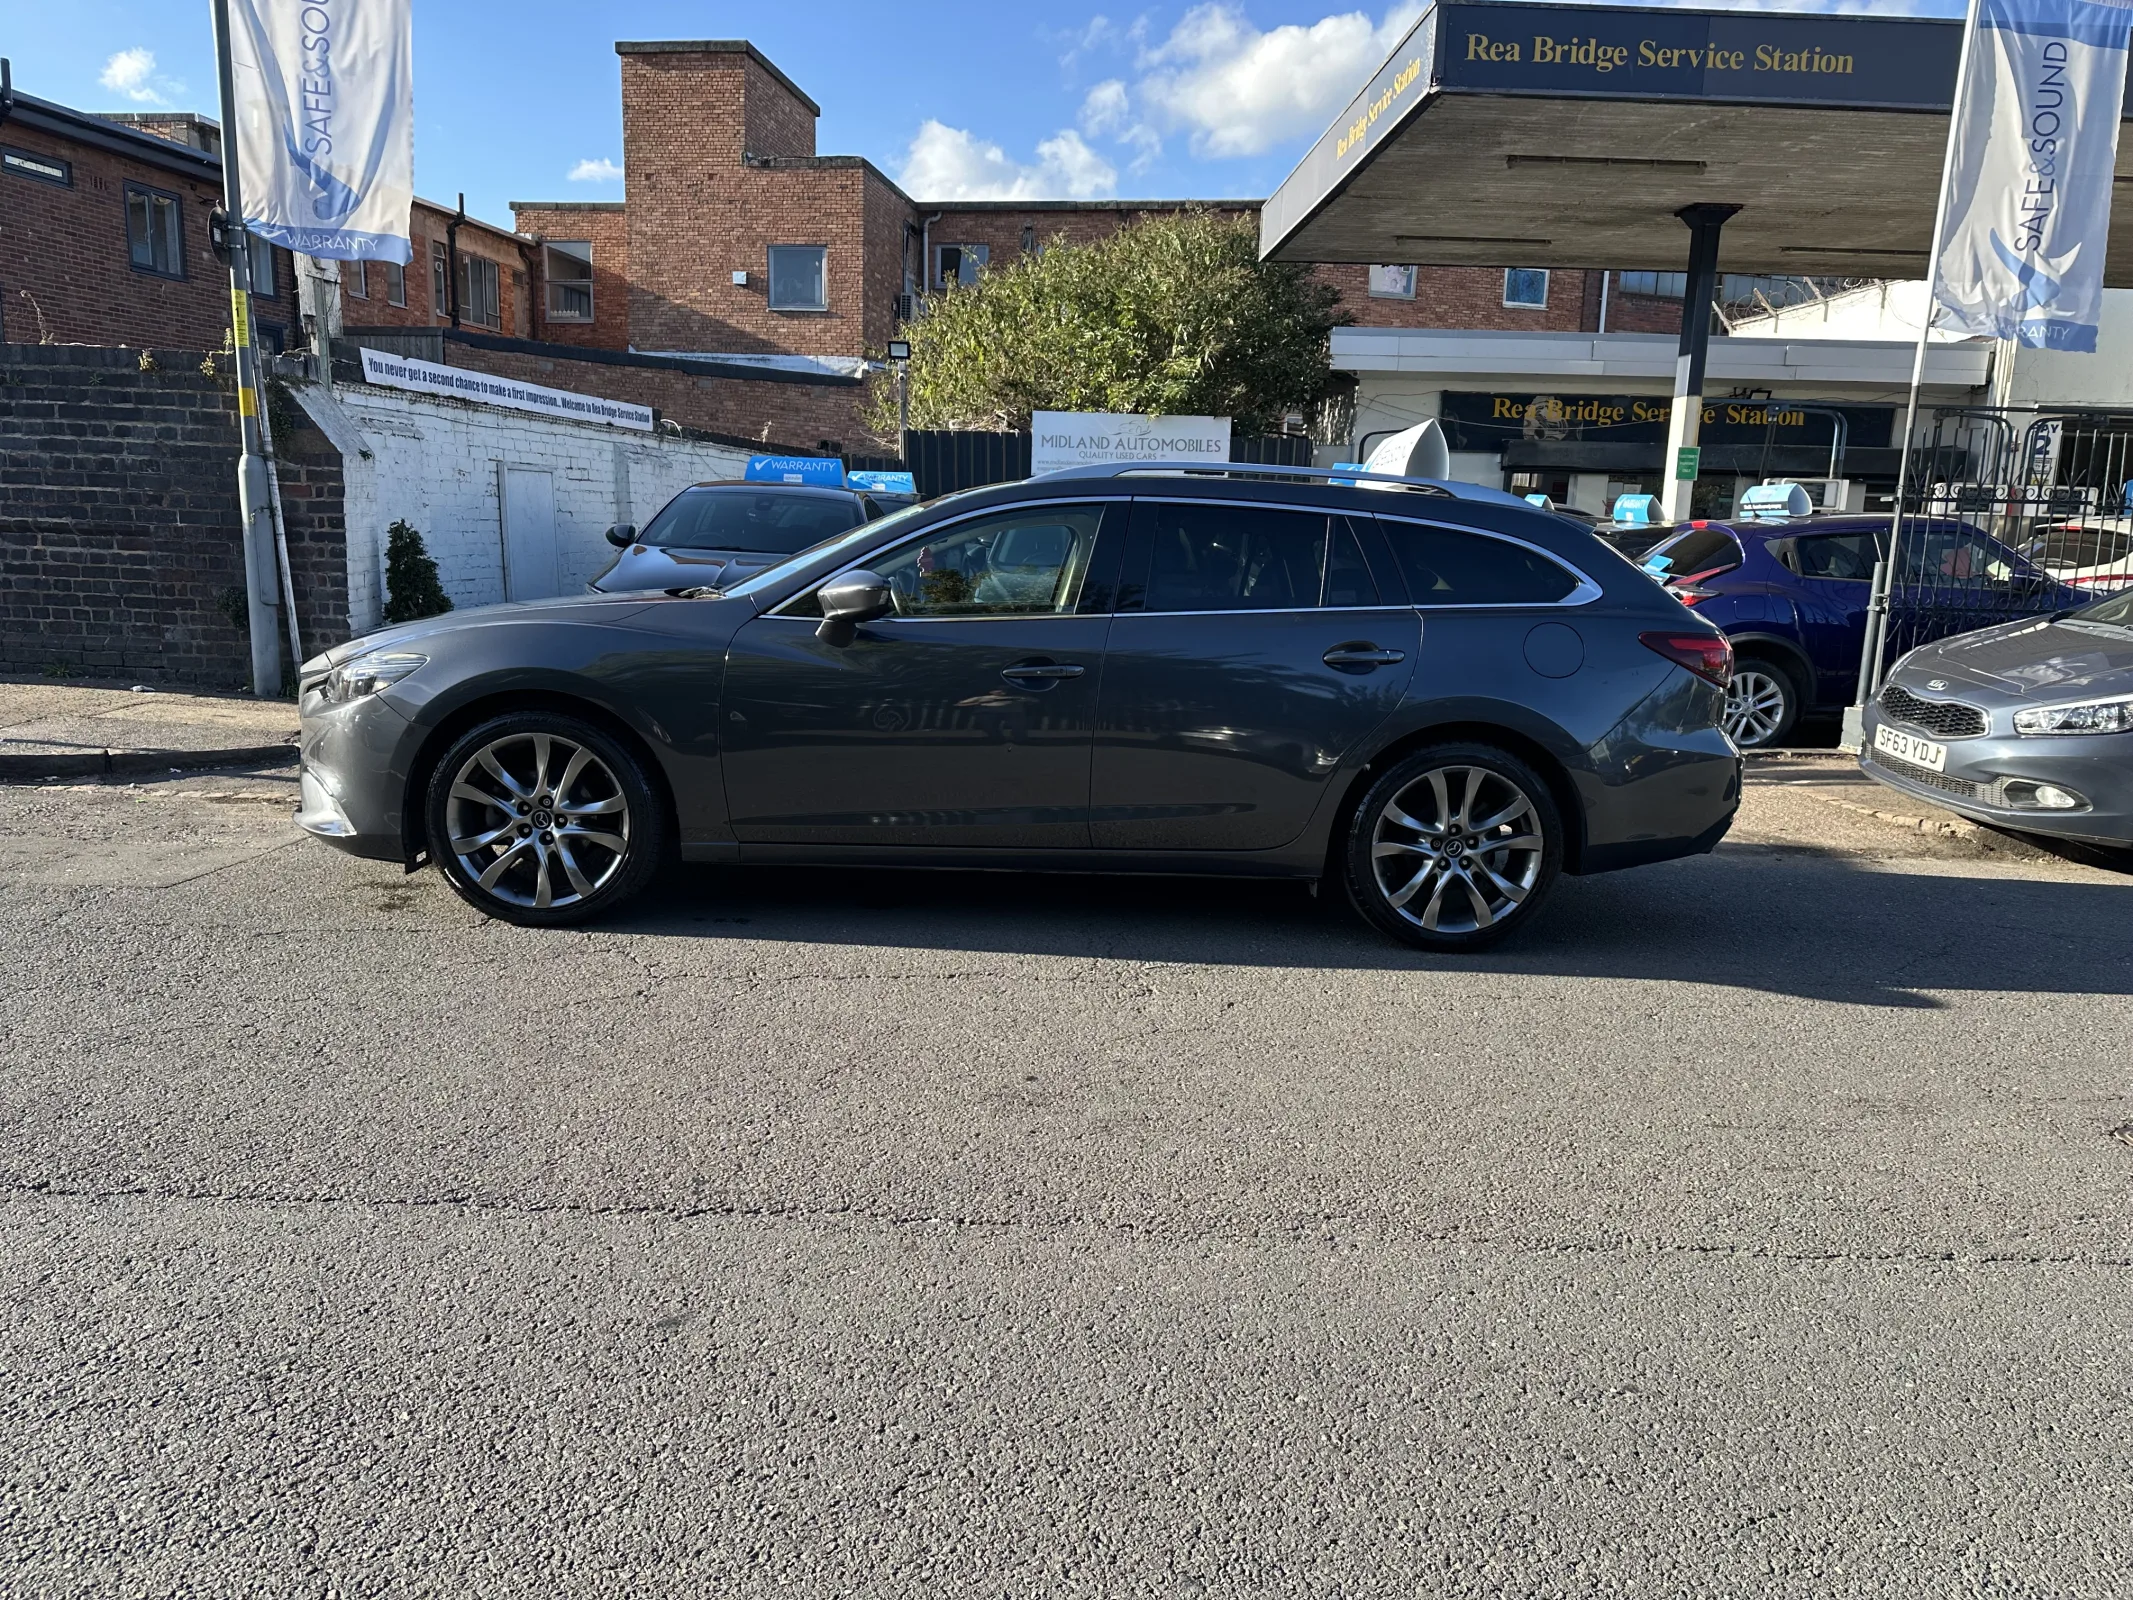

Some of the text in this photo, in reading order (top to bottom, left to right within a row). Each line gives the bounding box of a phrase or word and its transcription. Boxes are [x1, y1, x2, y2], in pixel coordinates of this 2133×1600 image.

[1465, 33, 1853, 74] Rea Bridge Service Station
[300, 0, 333, 155] SAFE&SO
[1336, 57, 1420, 160] Rea Bridge Service Station
[2014, 41, 2068, 252] SAFE&SOUND
[287, 233, 379, 251] WARRANTY
[368, 357, 384, 374] You
[385, 363, 407, 379] never
[408, 368, 421, 382] get
[422, 373, 428, 382] a
[428, 372, 454, 388] second
[455, 376, 480, 393] chance
[480, 381, 488, 393] to
[489, 384, 507, 398] make
[507, 388, 512, 398] a
[512, 387, 526, 401] first
[561, 397, 585, 412] Welcome
[586, 402, 592, 412] to
[592, 403, 601, 415] Rea
[601, 404, 617, 418] Bridge
[617, 407, 635, 420] Service
[634, 411, 650, 423] Station
[1492, 397, 1805, 426] Rea Bridge Sere Staton
[1041, 434, 1221, 453] MIDLAND AUTOMOBILES
[1078, 450, 1114, 459] QUALITY
[1115, 451, 1134, 460] USED
[1136, 452, 1157, 460] CARS
[2035, 434, 2052, 456] 2
[771, 460, 836, 472] WARRANTY
[1880, 728, 1941, 765] SF63 YDJ
